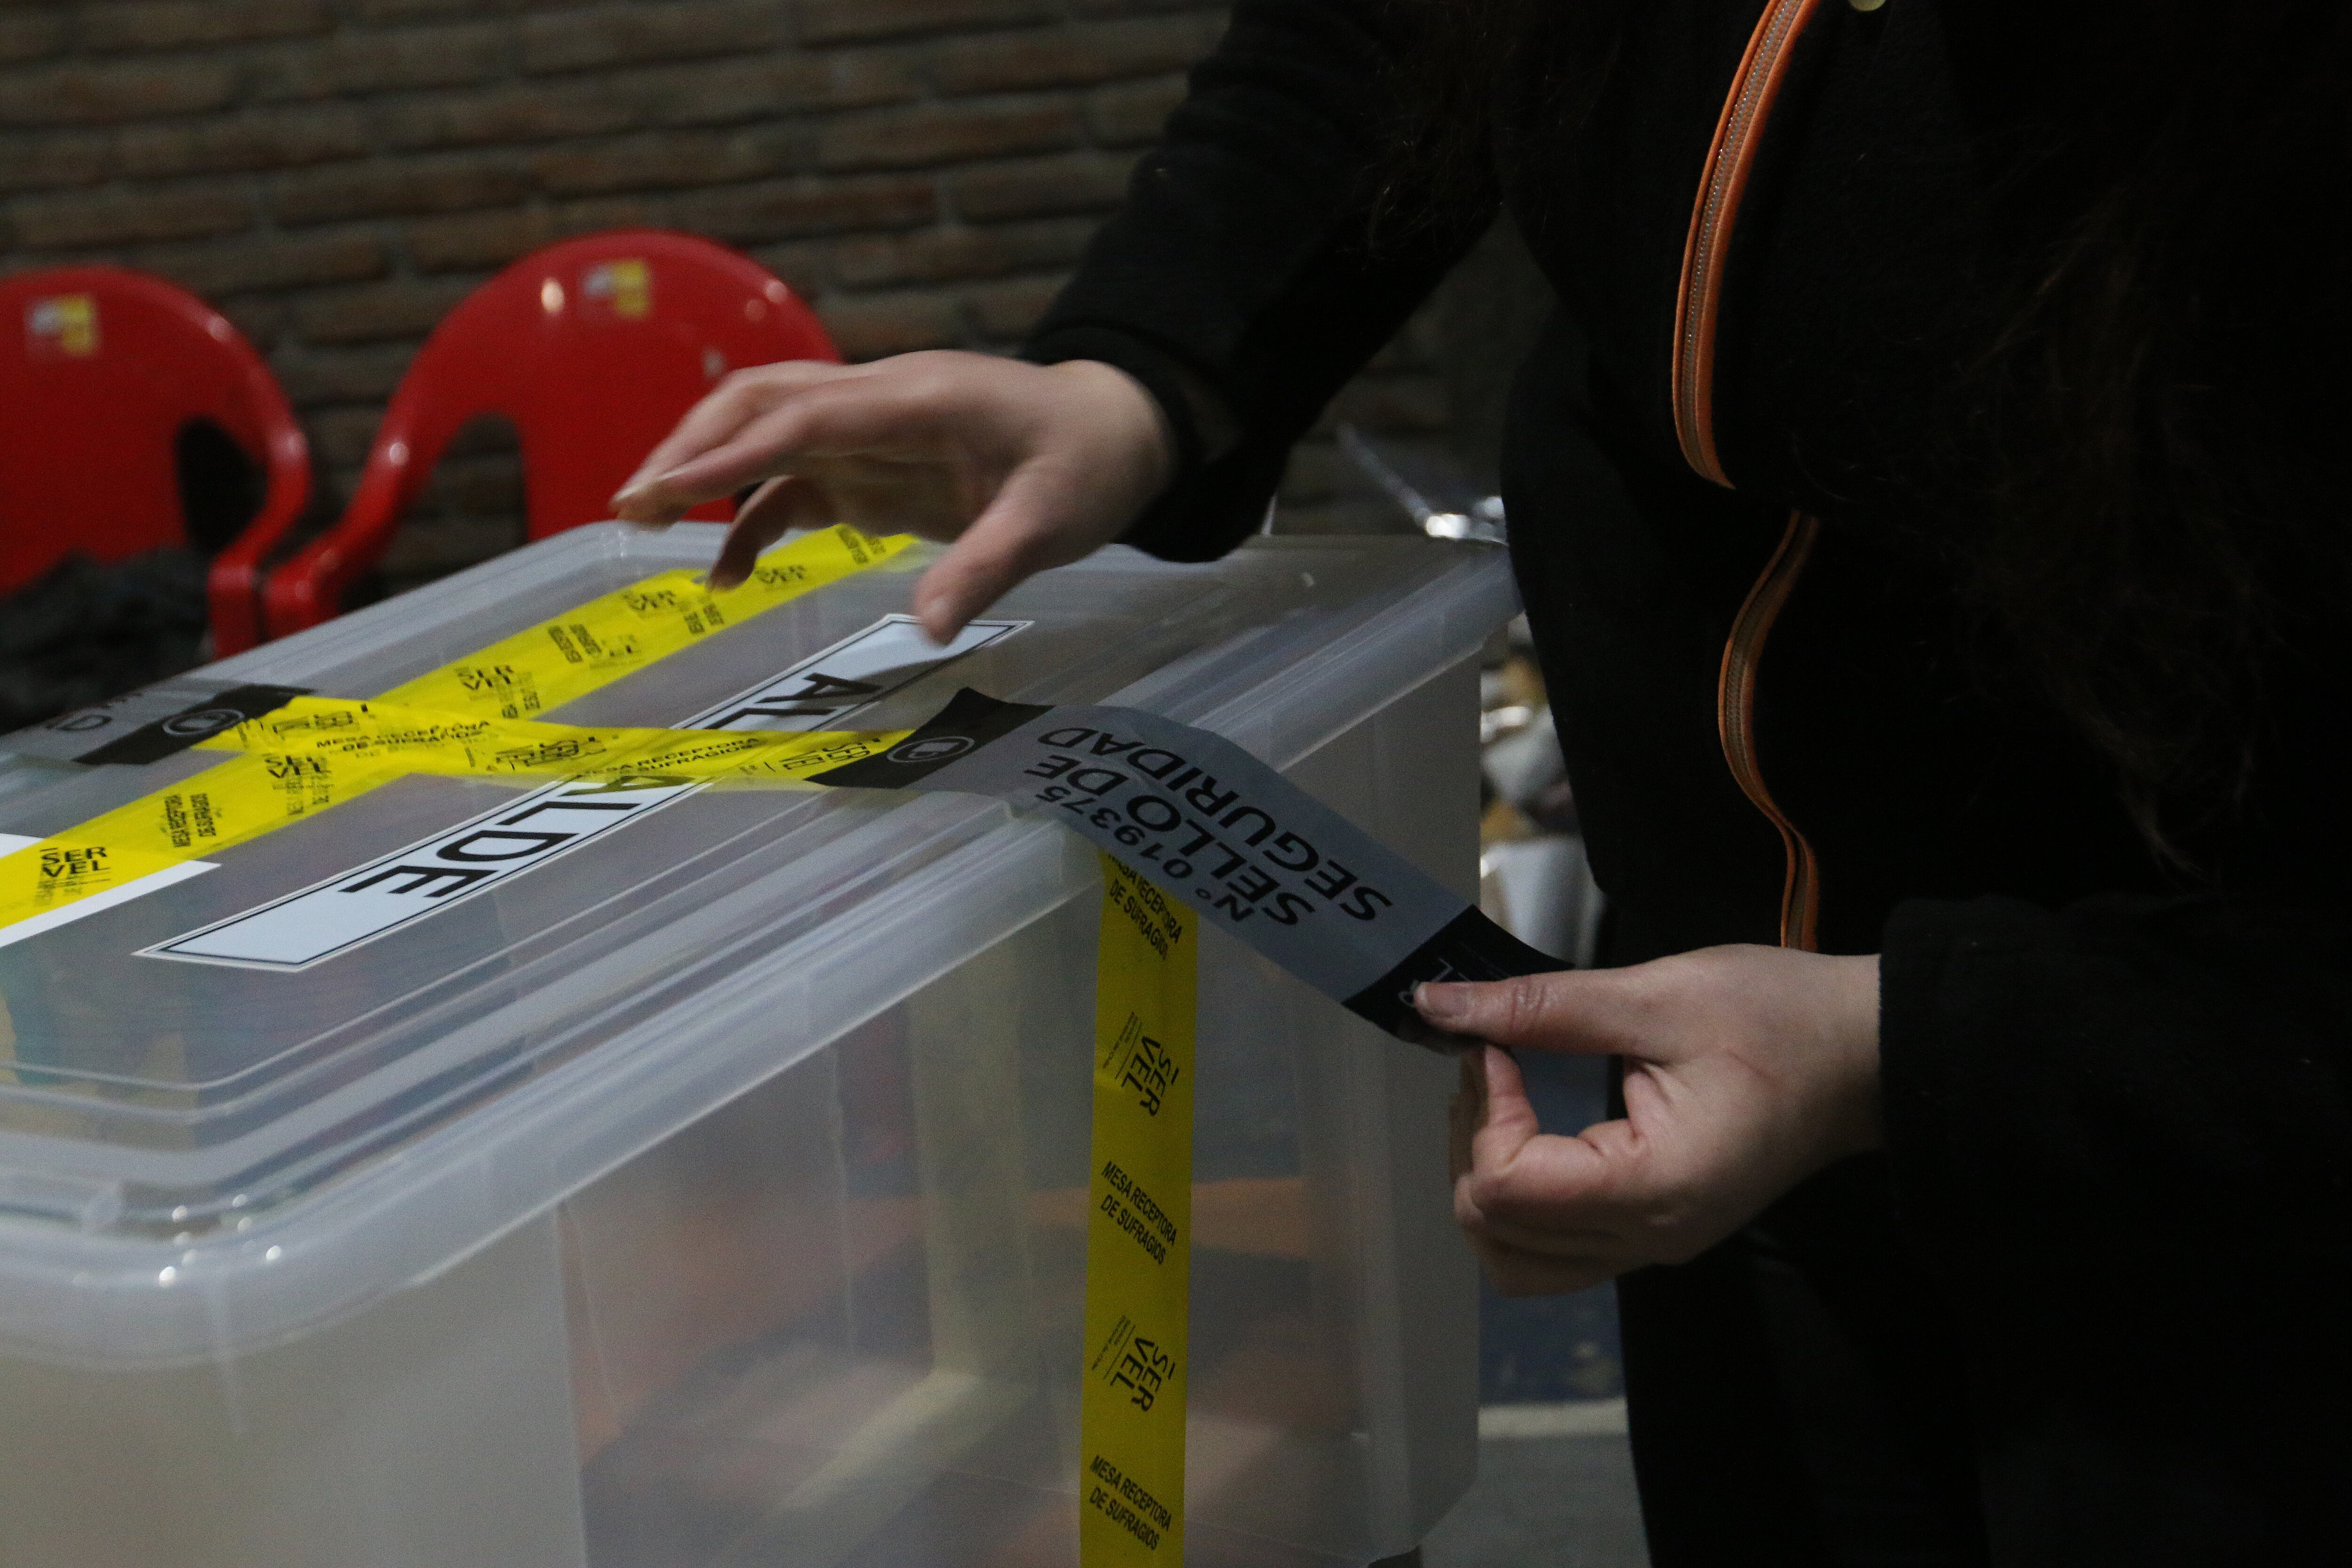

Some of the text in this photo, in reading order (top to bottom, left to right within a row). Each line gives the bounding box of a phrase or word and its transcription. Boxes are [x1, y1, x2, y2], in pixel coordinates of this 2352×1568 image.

[338, 673, 881, 898] ALALDE
[1024, 756, 1316, 925] SELLO DE
[1036, 786, 1193, 879] 019375
[1038, 728, 1393, 921] SEGURIDAD
[1109, 878, 1127, 905] DE
[1121, 1035, 1161, 1091] VEL
[1140, 1048, 1172, 1117] SER
[1100, 1194, 1167, 1265] DE SUFRAGIOS
[1101, 1160, 1177, 1246] MESA RECEPTORA
[1109, 1337, 1155, 1389] VEL
[1131, 1345, 1168, 1412] SER
[1089, 1455, 1173, 1532] MESA RECEPTORA
[1089, 1486, 1160, 1551] DE SUFRAGIOS
